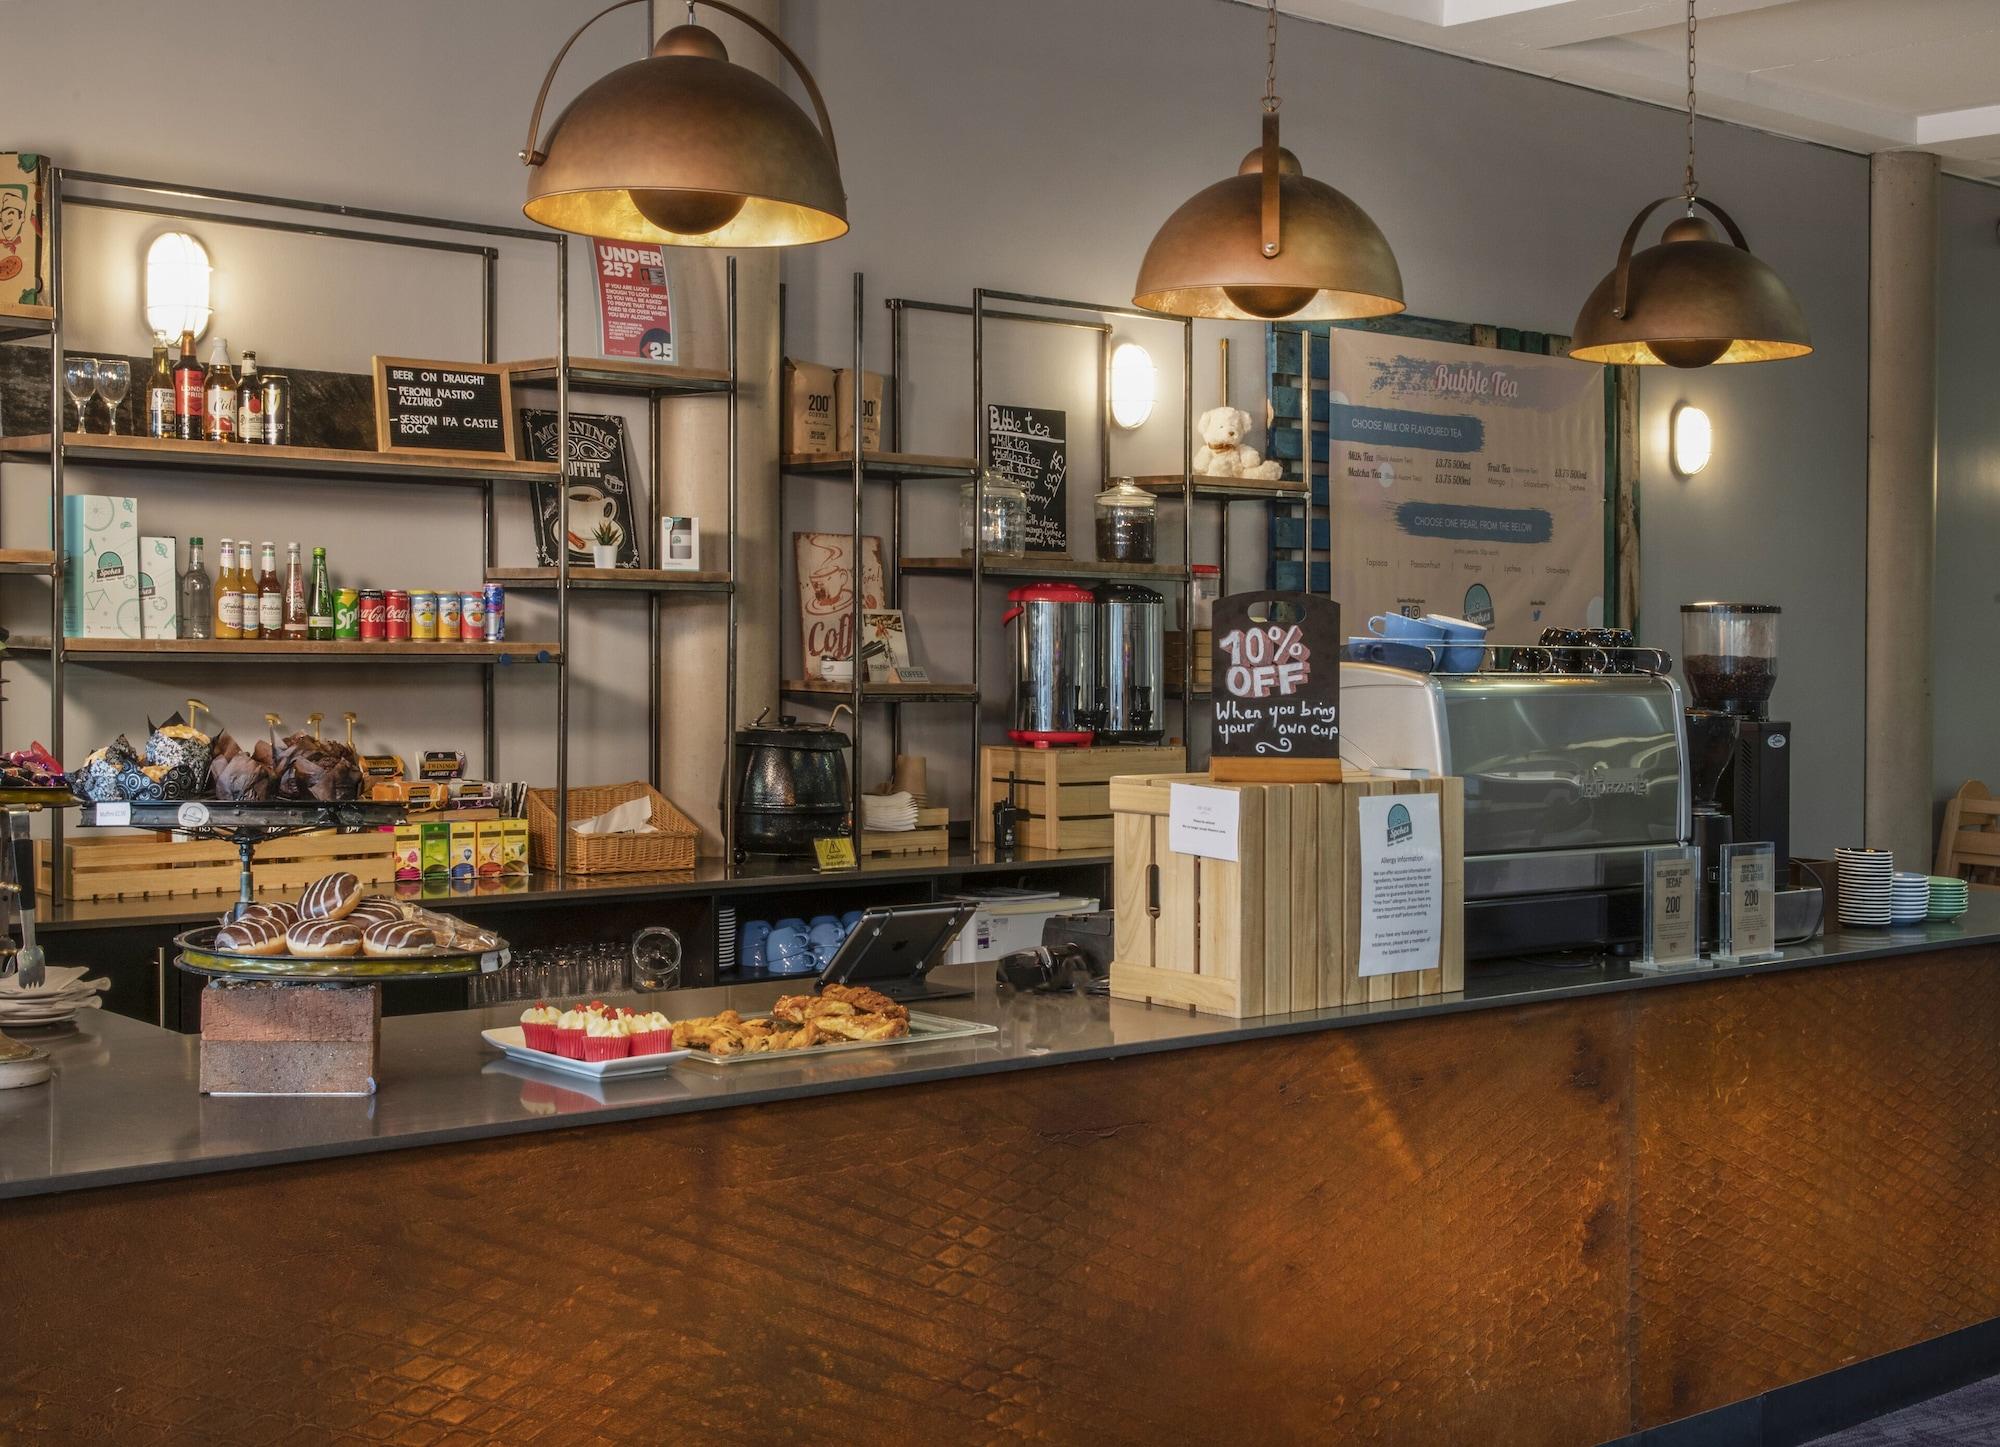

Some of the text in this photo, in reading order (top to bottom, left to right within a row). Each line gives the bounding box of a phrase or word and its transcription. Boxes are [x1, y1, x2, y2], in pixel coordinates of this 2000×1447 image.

[600, 245, 663, 267] UNDER
[603, 260, 633, 278] 25?
[393, 370, 485, 386] BEER ON DRAUGHT
[1435, 364, 1519, 398] Bubble Tea
[399, 386, 475, 400] PERONI NASTRO
[400, 396, 442, 407] AZZURRO
[400, 414, 498, 429] SESSION IPA CASTLE
[400, 424, 429, 435] ROCK
[1025, 411, 1050, 438] tea
[1351, 418, 1462, 438] CHOOSE MILK OR FLAVOURED TEA
[535, 420, 617, 449] MONING
[1013, 436, 1030, 451] tea
[1025, 454, 1041, 466] tea
[1348, 450, 1362, 461] Milk
[1363, 452, 1374, 462] Tea
[568, 461, 601, 478] OFFEE
[1348, 467, 1370, 479] Matcha
[1371, 468, 1382, 479] Tea
[1414, 516, 1532, 532] CHOOSE ONE PEARL FROM THE BELOW
[1219, 625, 1311, 667] 10%
[1225, 661, 1311, 698] OFF
[1216, 700, 1336, 728] When you bring
[1219, 723, 1339, 744] your own cup
[1665, 877, 1682, 888] DECAF
